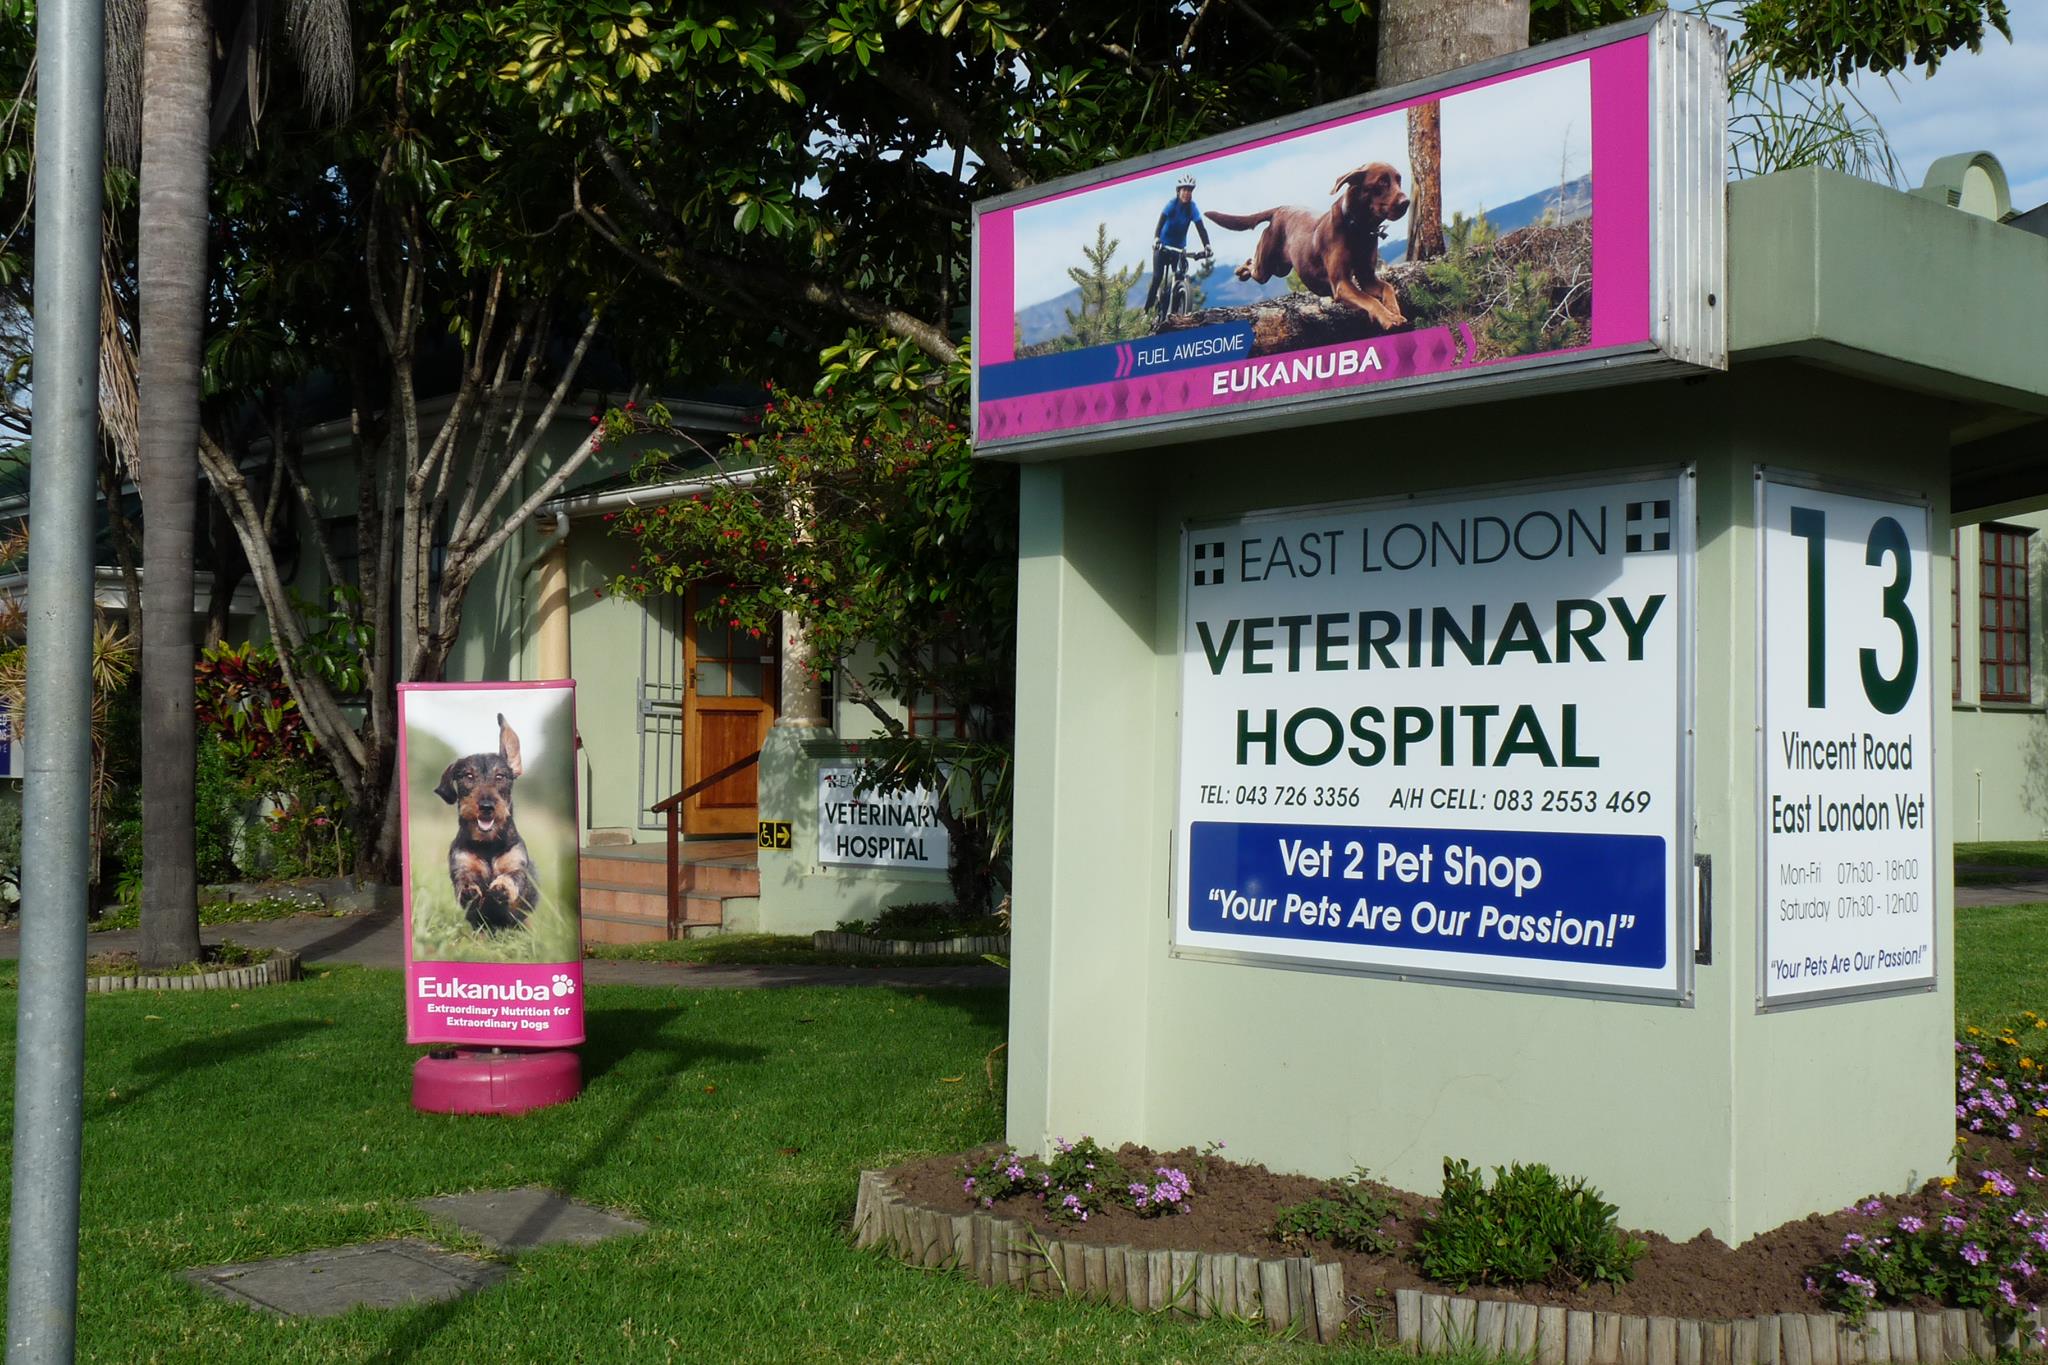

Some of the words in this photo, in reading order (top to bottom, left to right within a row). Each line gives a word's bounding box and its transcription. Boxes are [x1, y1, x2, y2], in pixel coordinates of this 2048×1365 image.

[1138, 348, 1169, 366] FUEL
[1173, 334, 1244, 360] AWESOME
[1212, 346, 1382, 395] EUKANUBA
[1241, 530, 1344, 582] EAST
[1363, 505, 1607, 572] LONDON
[1790, 506, 1919, 715] 13
[1195, 594, 1667, 676] VETERINARY
[1236, 704, 1600, 768] HOSPITAL
[1782, 731, 1857, 770] Vincent
[1863, 733, 1913, 770] Road
[1200, 785, 1230, 804] TEL:
[1235, 785, 1268, 805] 043
[1274, 786, 1307, 806] 726
[1313, 787, 1360, 808] 3356
[1389, 788, 1424, 810] A/H
[1430, 788, 1486, 810] CELL:
[1493, 789, 1533, 811] 083
[1541, 790, 1597, 812] 2553
[1605, 790, 1651, 813] 469
[825, 802, 940, 828] VETERINARY
[1772, 794, 1811, 833] East
[1818, 794, 1889, 832] London
[1895, 793, 1925, 829] Vet
[837, 835, 928, 861] HOSPITAL
[1279, 839, 1333, 877] Vet
[1343, 841, 1364, 879] 2
[1377, 843, 1433, 883] Pet
[1444, 845, 1542, 897] Shop
[1780, 862, 1821, 885] Mon-Fri
[1838, 861, 1873, 884] 07h30
[1885, 859, 1918, 881] 18h00
[1283, 893, 1341, 927] Pets
[1347, 898, 1401, 932] Are
[1411, 901, 1470, 936] Our
[1780, 896, 1830, 922] Saturday
[1838, 895, 1873, 919] 07h30
[1885, 891, 1918, 914] 12h00
[1804, 955, 1827, 977] Pets
[1830, 954, 1850, 974] Are
[1854, 951, 1875, 971] Our
[418, 977, 549, 1001] Eukanuba
[427, 1003, 498, 1018] Extraordinary
[501, 1006, 550, 1017] Nutrition
[554, 1006, 571, 1016] for
[446, 1016, 518, 1030] Extraordinary
[521, 1019, 549, 1031] Dogs
